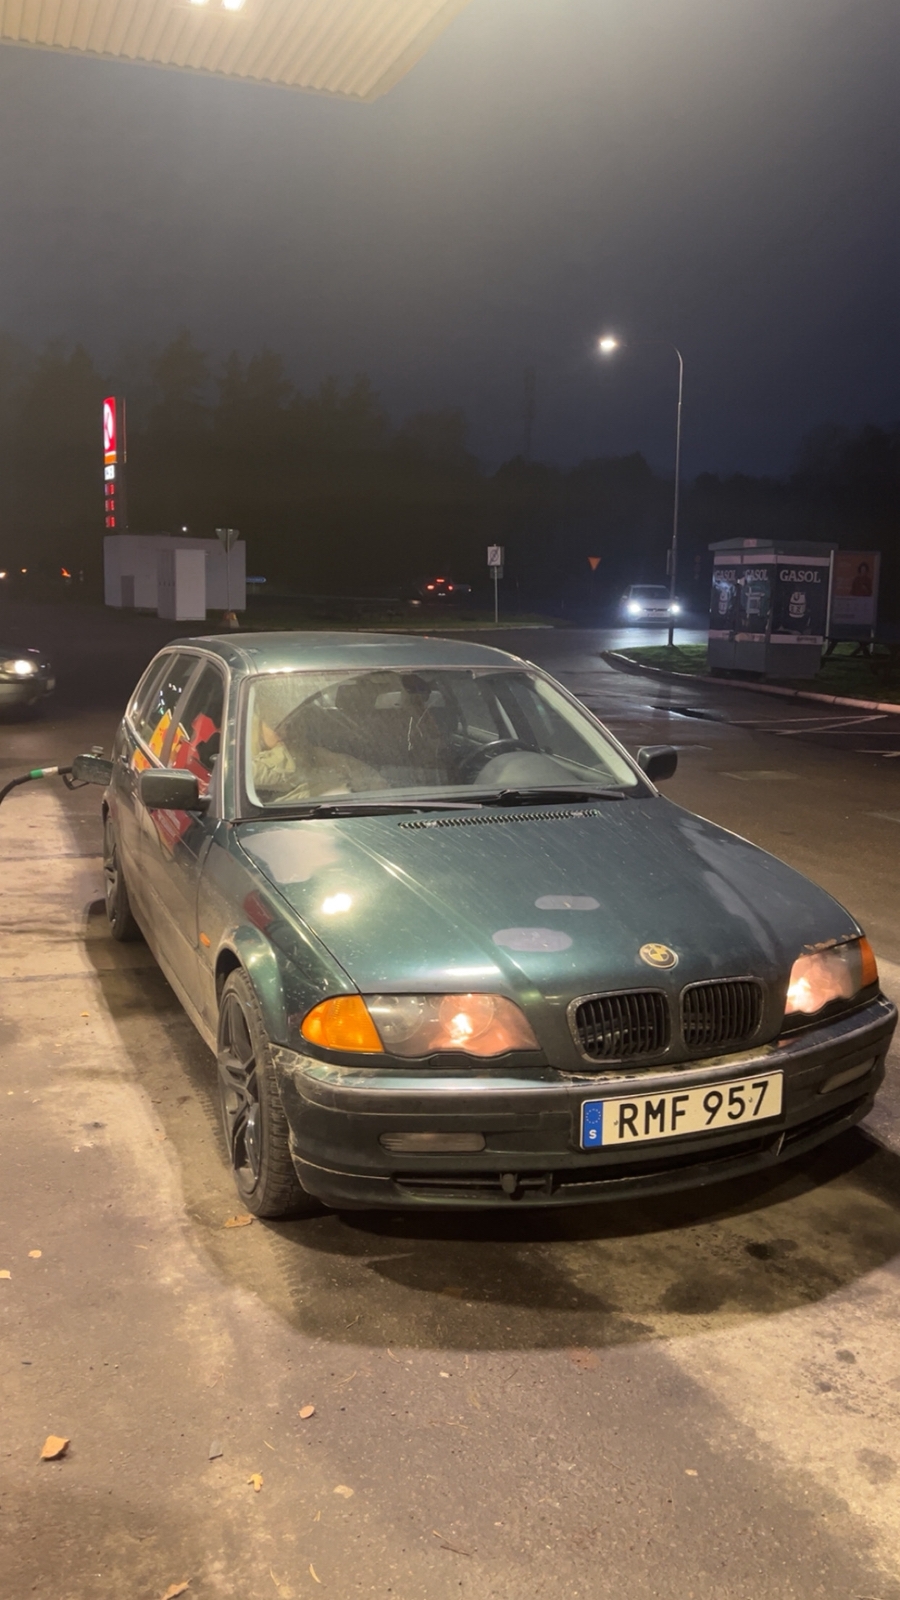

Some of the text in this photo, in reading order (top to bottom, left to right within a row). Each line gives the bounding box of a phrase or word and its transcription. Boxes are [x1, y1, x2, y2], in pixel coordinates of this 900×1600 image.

[745, 569, 768, 580] GASOL
[779, 570, 820, 583] GASOL
[618, 1081, 769, 1138] RMF 957
[588, 1129, 597, 1139] S
